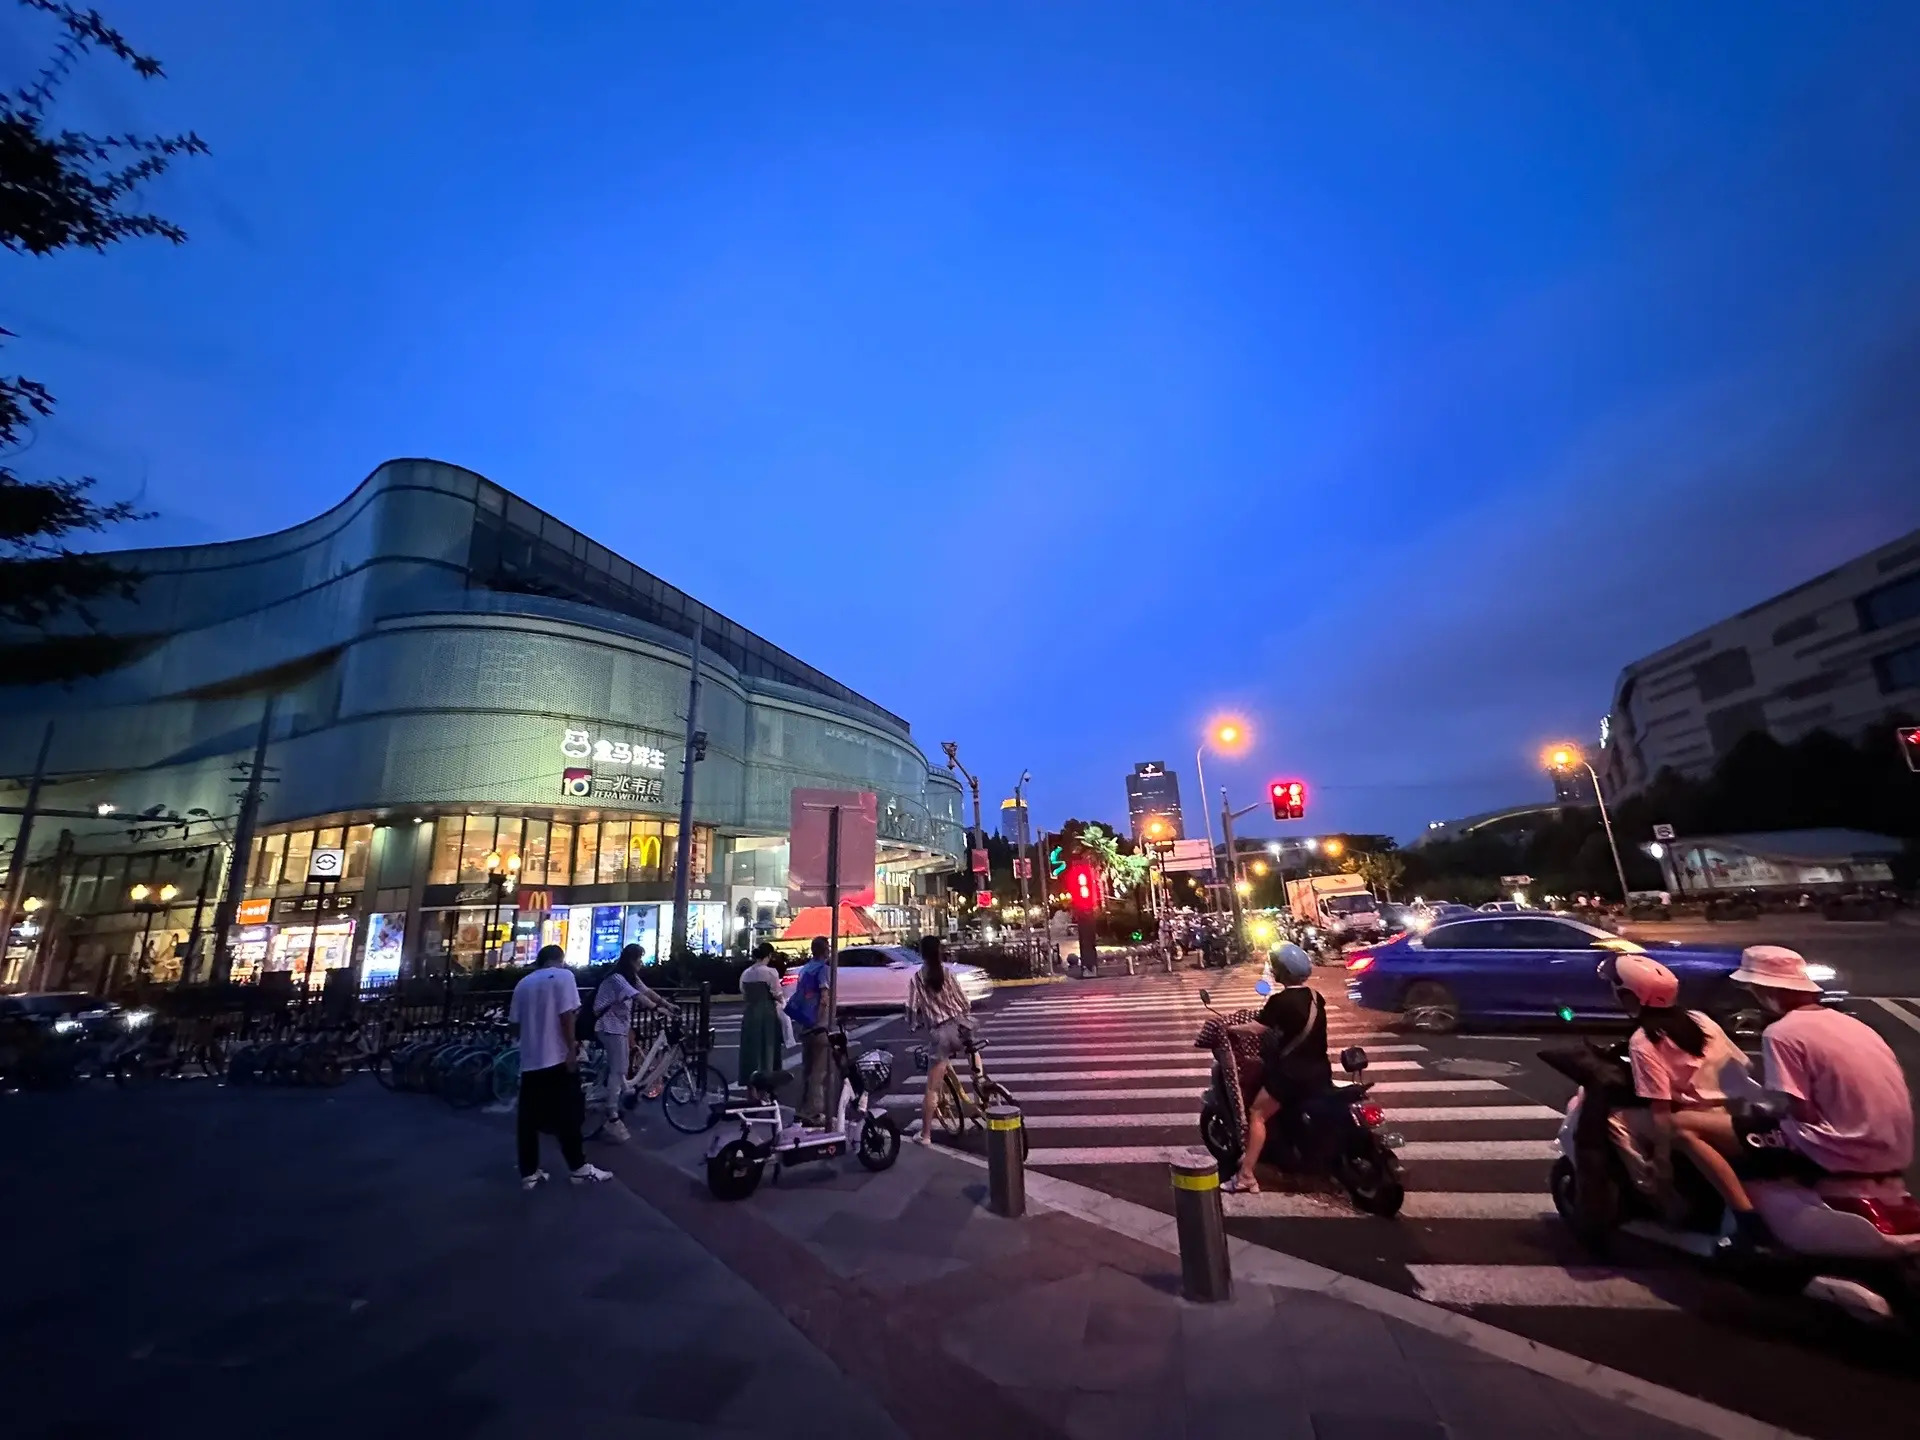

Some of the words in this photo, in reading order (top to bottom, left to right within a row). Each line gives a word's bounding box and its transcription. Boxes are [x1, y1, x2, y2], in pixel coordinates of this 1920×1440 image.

[592, 739, 665, 769] 盒马鲜生
[595, 775, 662, 796] 一兆韦德
